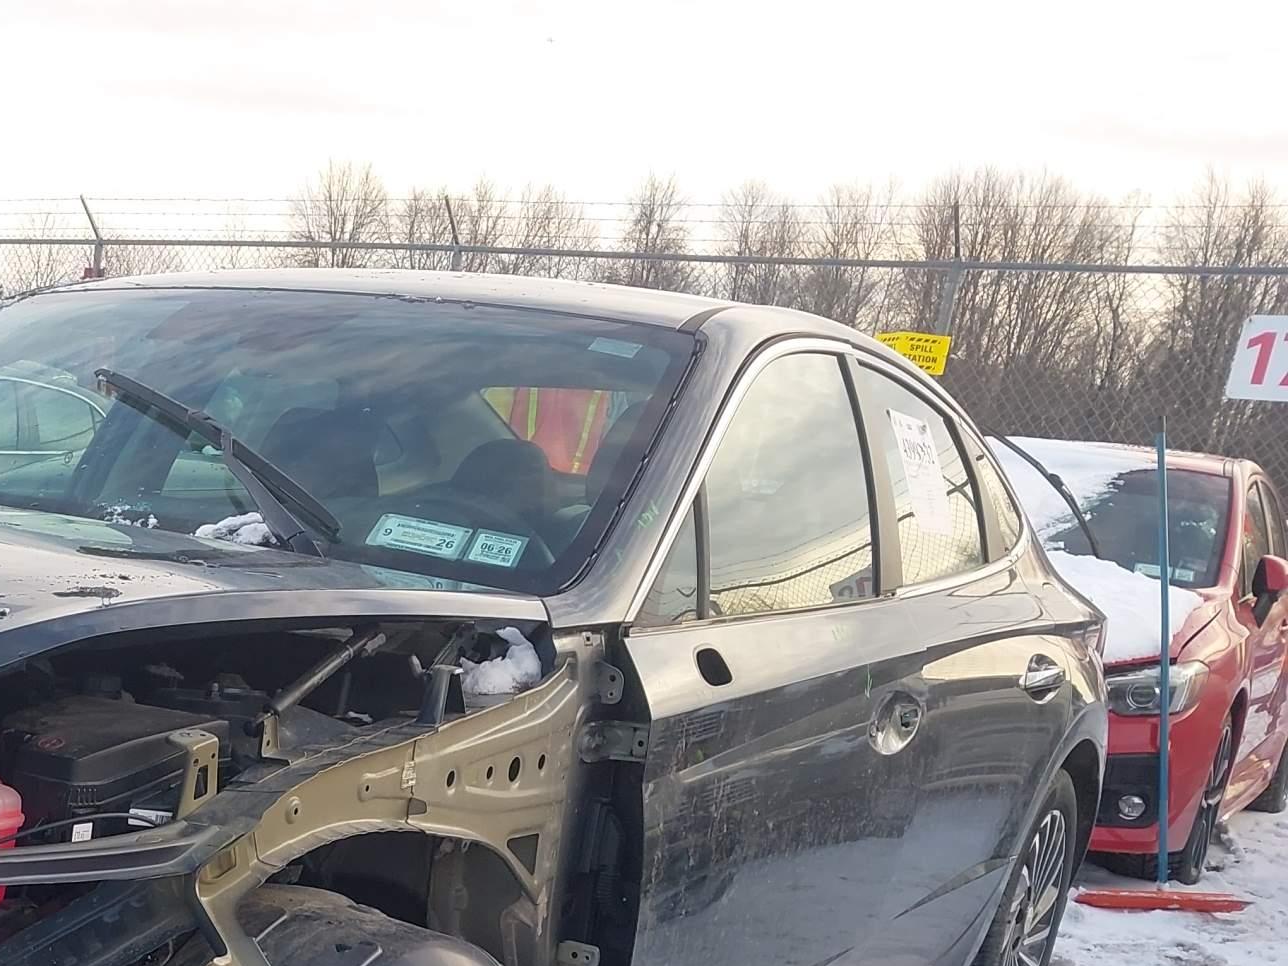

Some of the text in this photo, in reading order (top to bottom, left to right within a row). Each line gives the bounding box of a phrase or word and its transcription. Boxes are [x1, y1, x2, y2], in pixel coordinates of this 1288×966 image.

[909, 343, 934, 353] SPILL
[1246, 331, 1288, 386] 1
[382, 527, 393, 537] 9
[436, 538, 455, 549] 26
